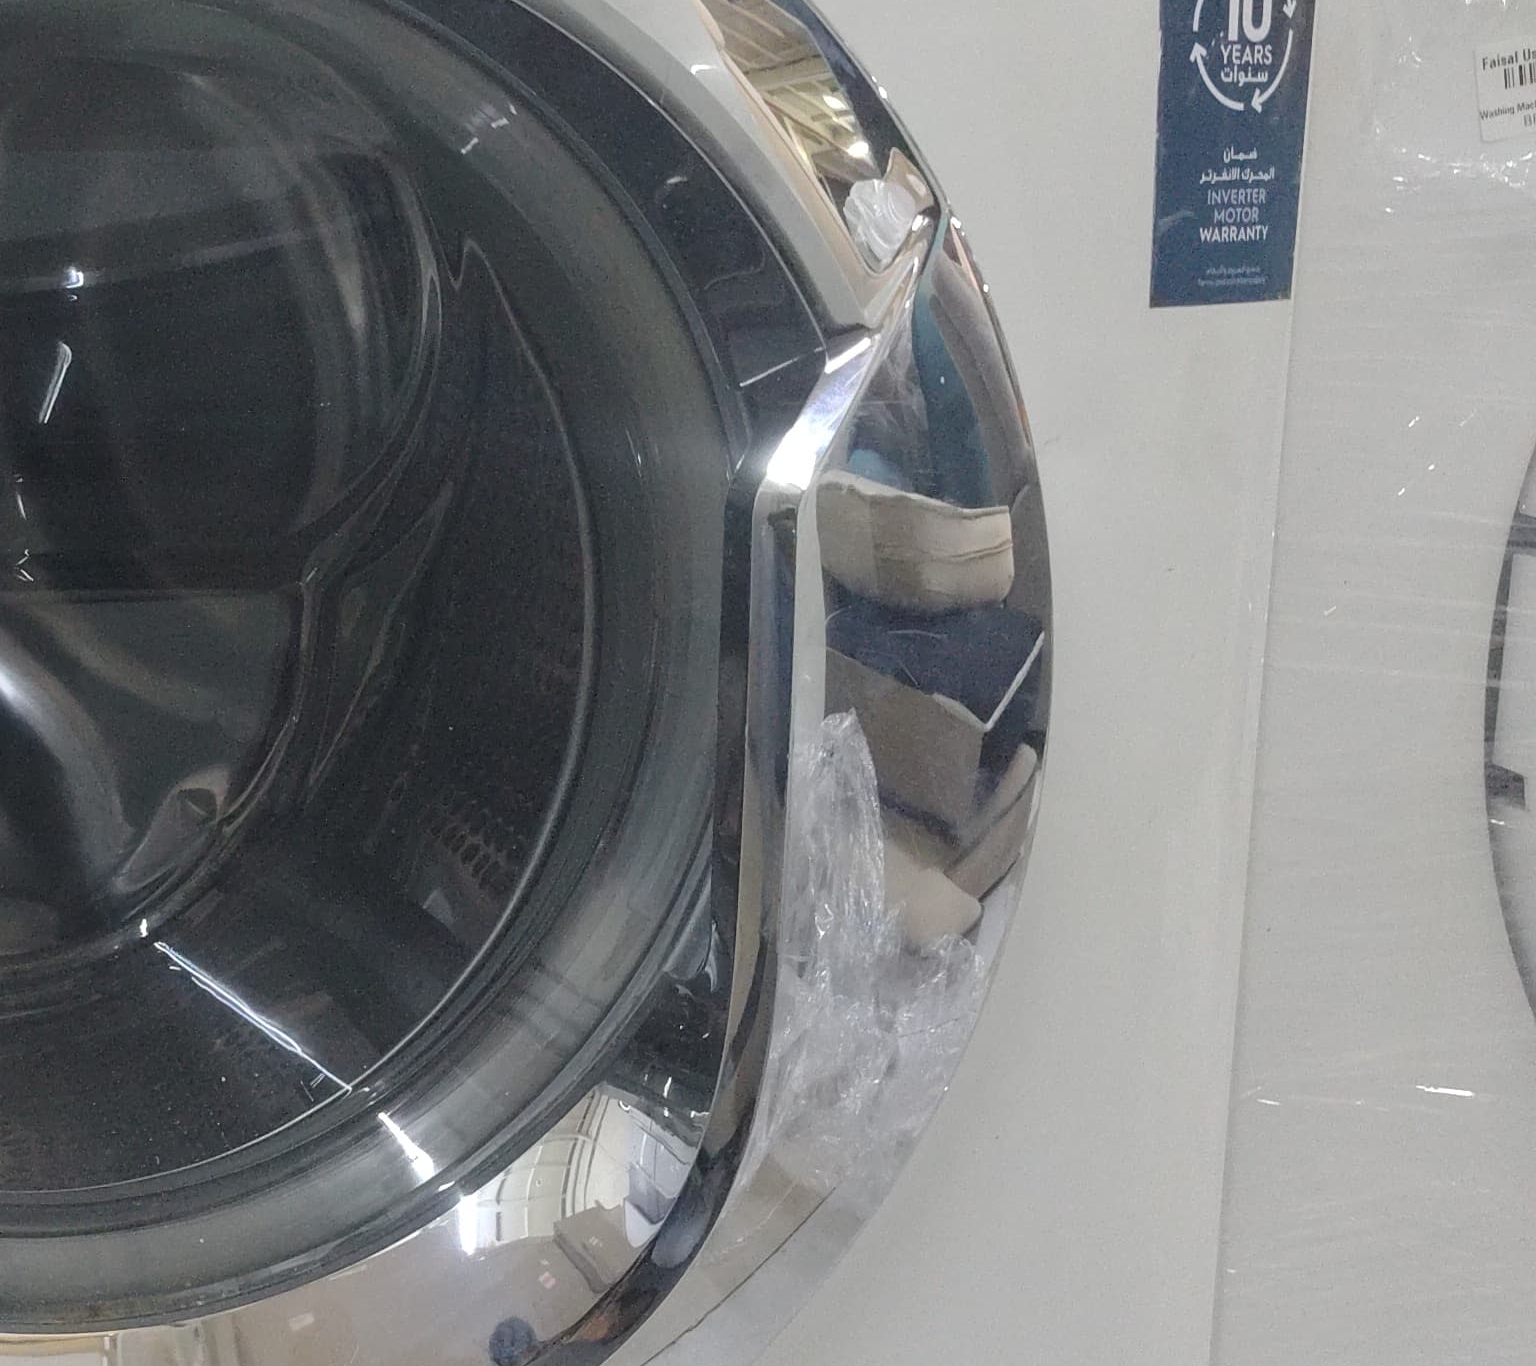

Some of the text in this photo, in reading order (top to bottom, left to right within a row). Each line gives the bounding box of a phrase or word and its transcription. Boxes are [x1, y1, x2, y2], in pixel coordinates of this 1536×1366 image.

[1220, 44, 1273, 65] YEARS
[1220, 64, 1268, 87] سنوات
[1207, 188, 1266, 205] INVERTER
[1214, 207, 1259, 223] MOTOR
[1199, 225, 1269, 243] WARRANTY
